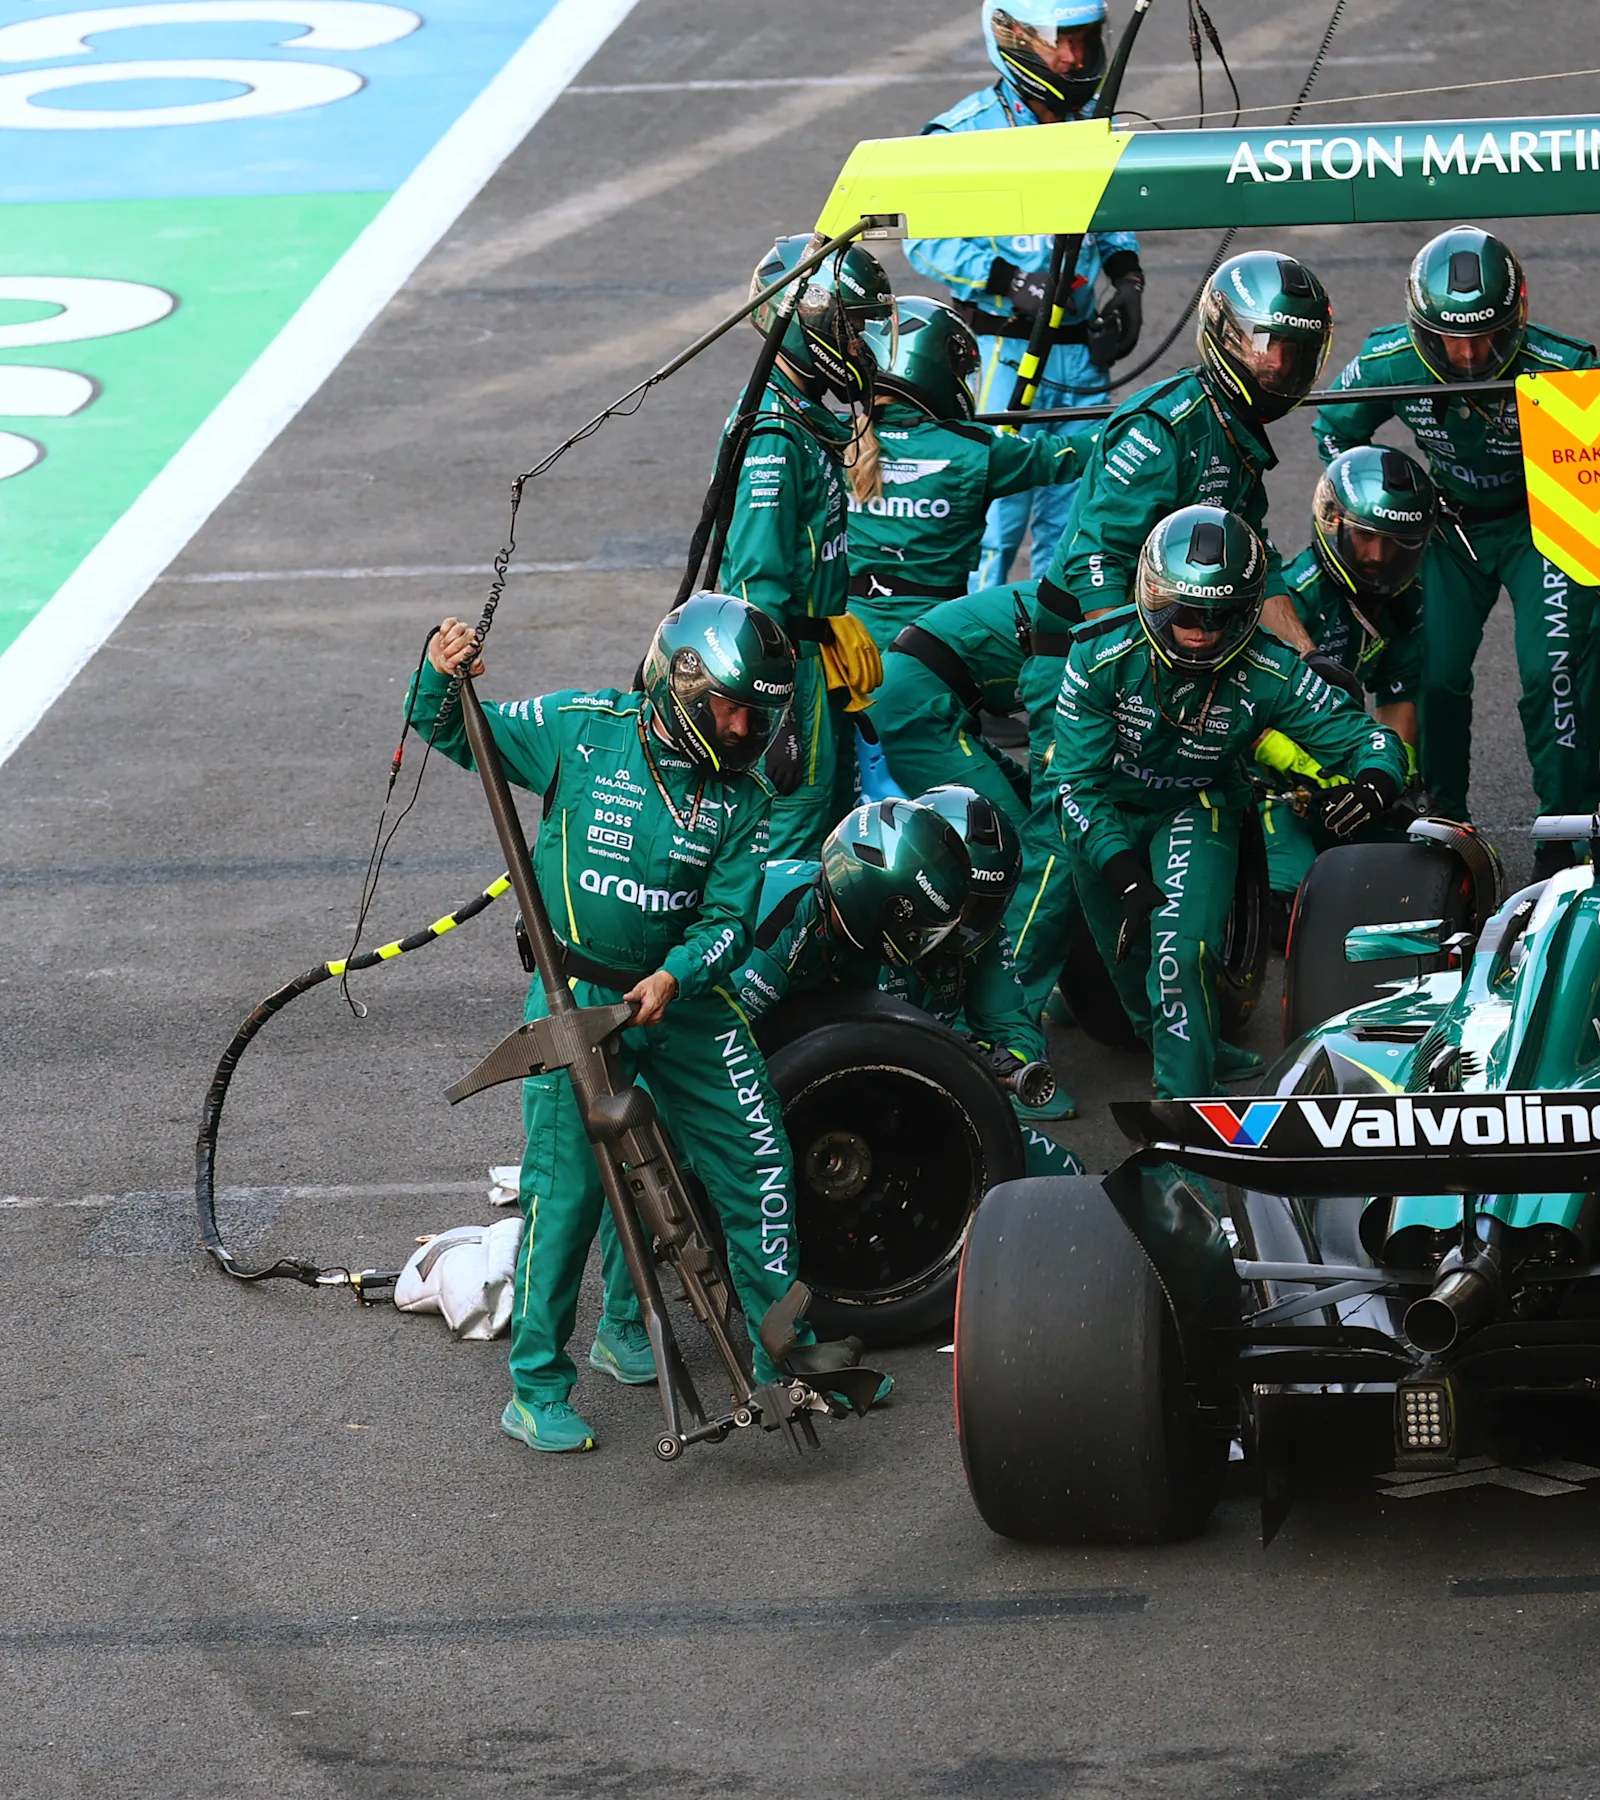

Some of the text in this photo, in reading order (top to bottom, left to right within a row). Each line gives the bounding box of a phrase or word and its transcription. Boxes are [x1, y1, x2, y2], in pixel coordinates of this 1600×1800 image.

[1226, 136, 1404, 183] ASTON
[1273, 311, 1323, 329] aramco
[1440, 307, 1496, 324] aramco
[1372, 506, 1423, 522] aramco
[1176, 580, 1234, 597] aramco
[703, 626, 741, 681] Valvoline
[1096, 637, 1133, 660] coinbase
[571, 696, 615, 708] coinbase
[1548, 650, 1576, 749] ASTON
[1118, 702, 1156, 718] AADEN
[672, 705, 710, 760] ASTON MARTIN
[1118, 723, 1143, 741] OSS
[659, 758, 693, 769] aramco
[594, 774, 648, 797] MAADEN
[591, 790, 645, 812] cognizant
[594, 808, 633, 828] BOSS
[590, 828, 632, 848] JCB
[587, 845, 631, 863] SentinelOne
[668, 849, 708, 868] CoreWeave
[579, 868, 700, 913] aramco
[915, 869, 952, 914] Valvoline
[1514, 900, 1533, 917] BOSS
[1155, 807, 1195, 1043] ASTON MARTIN
[1364, 920, 1429, 934] BOSS
[715, 1028, 790, 1276] ASTON MARTIN
